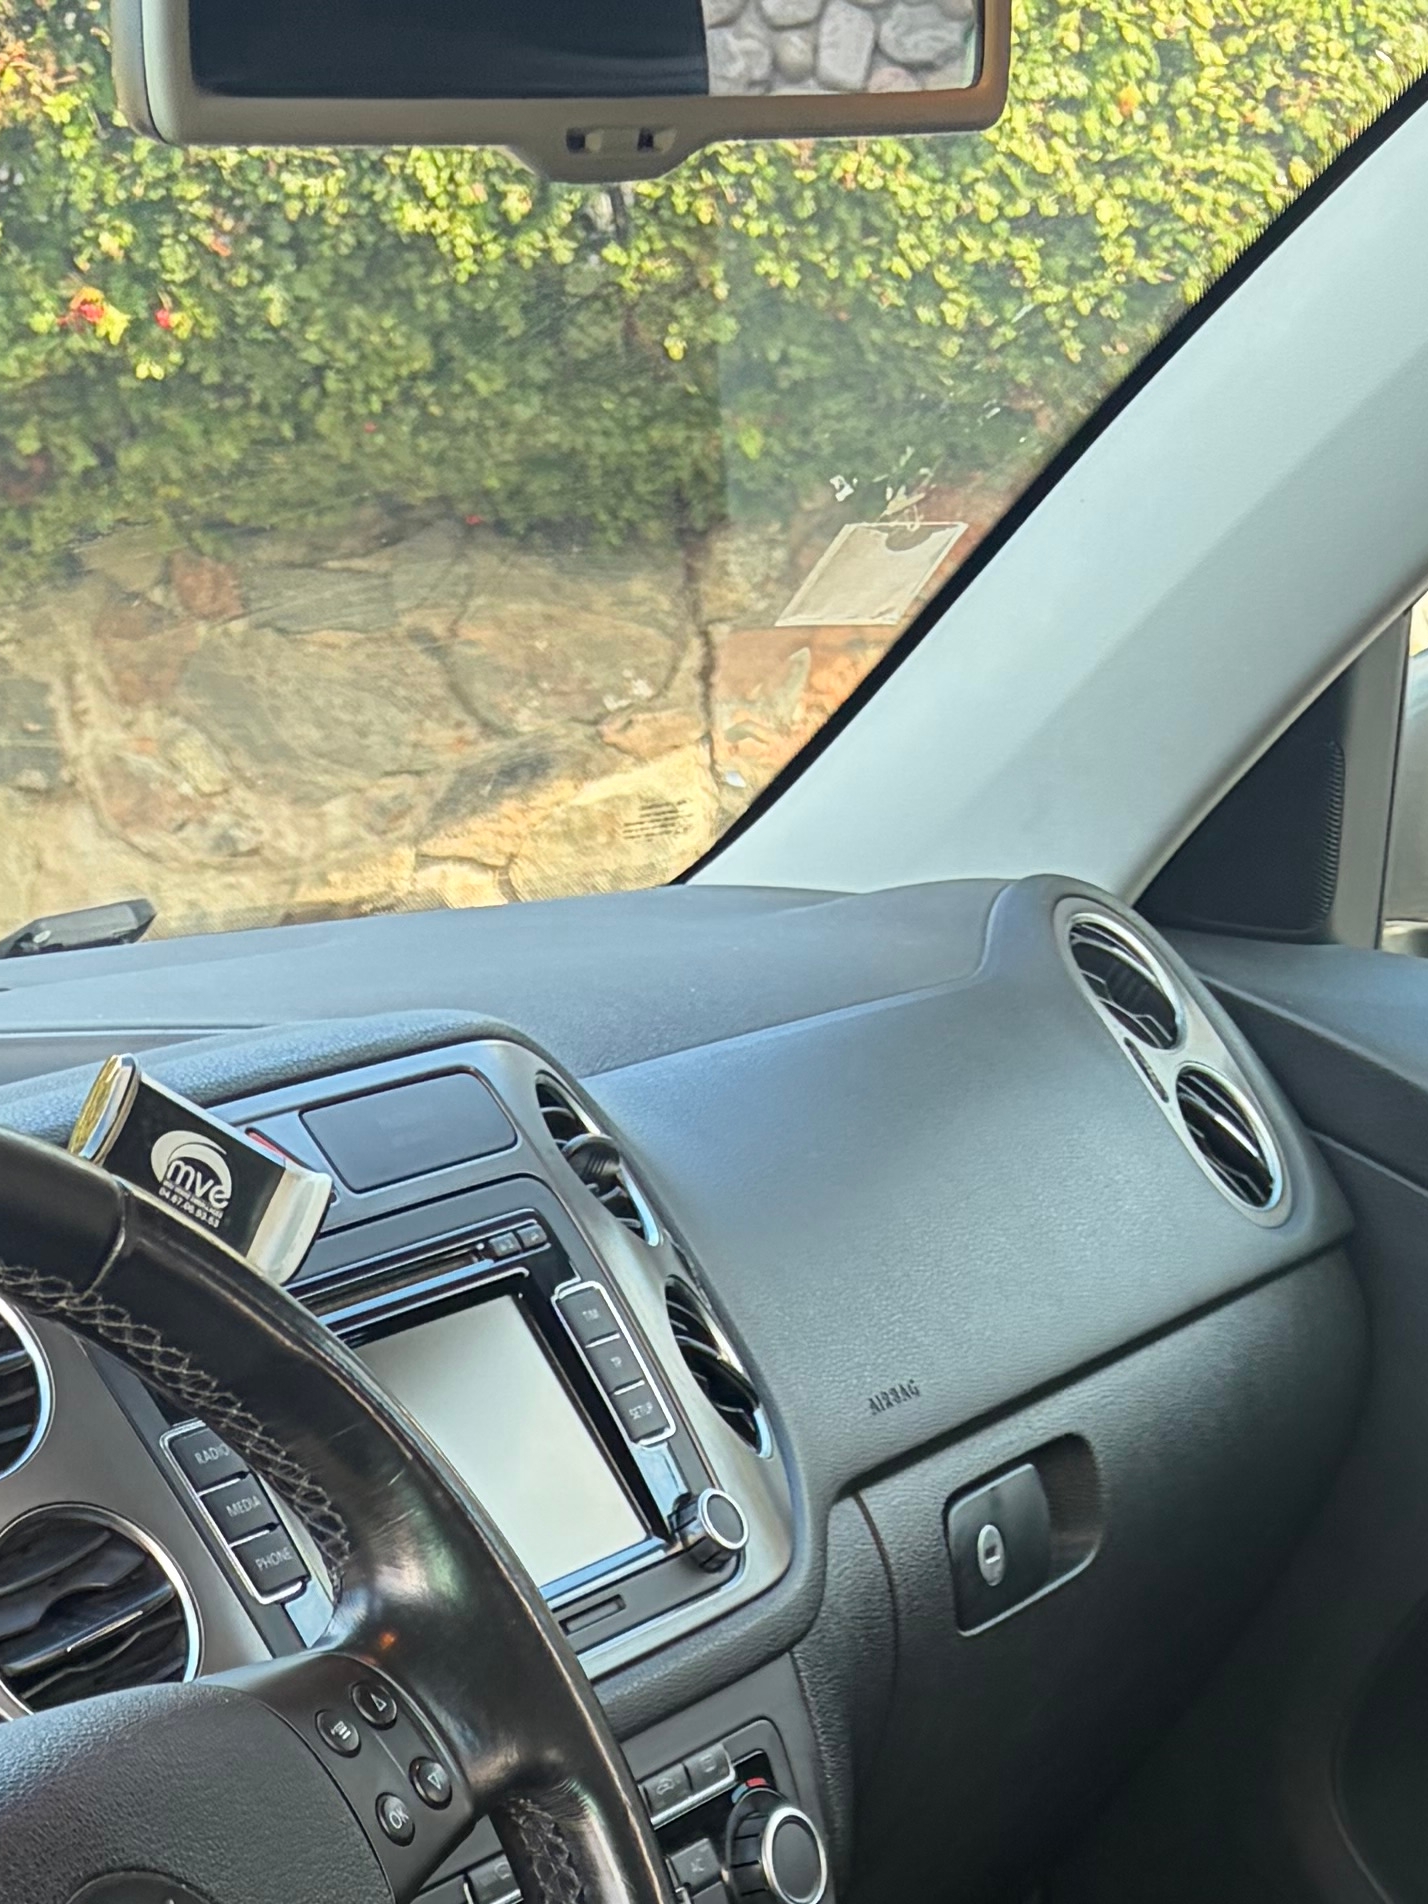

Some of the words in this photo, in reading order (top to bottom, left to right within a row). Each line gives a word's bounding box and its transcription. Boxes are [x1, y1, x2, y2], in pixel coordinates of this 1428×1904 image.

[869, 1379, 920, 1416] AIRBAG
[194, 1444, 230, 1465] RADIO
[225, 1495, 262, 1517] MEDIA
[255, 1547, 294, 1572] PHONE
[388, 1809, 409, 1829] OK
